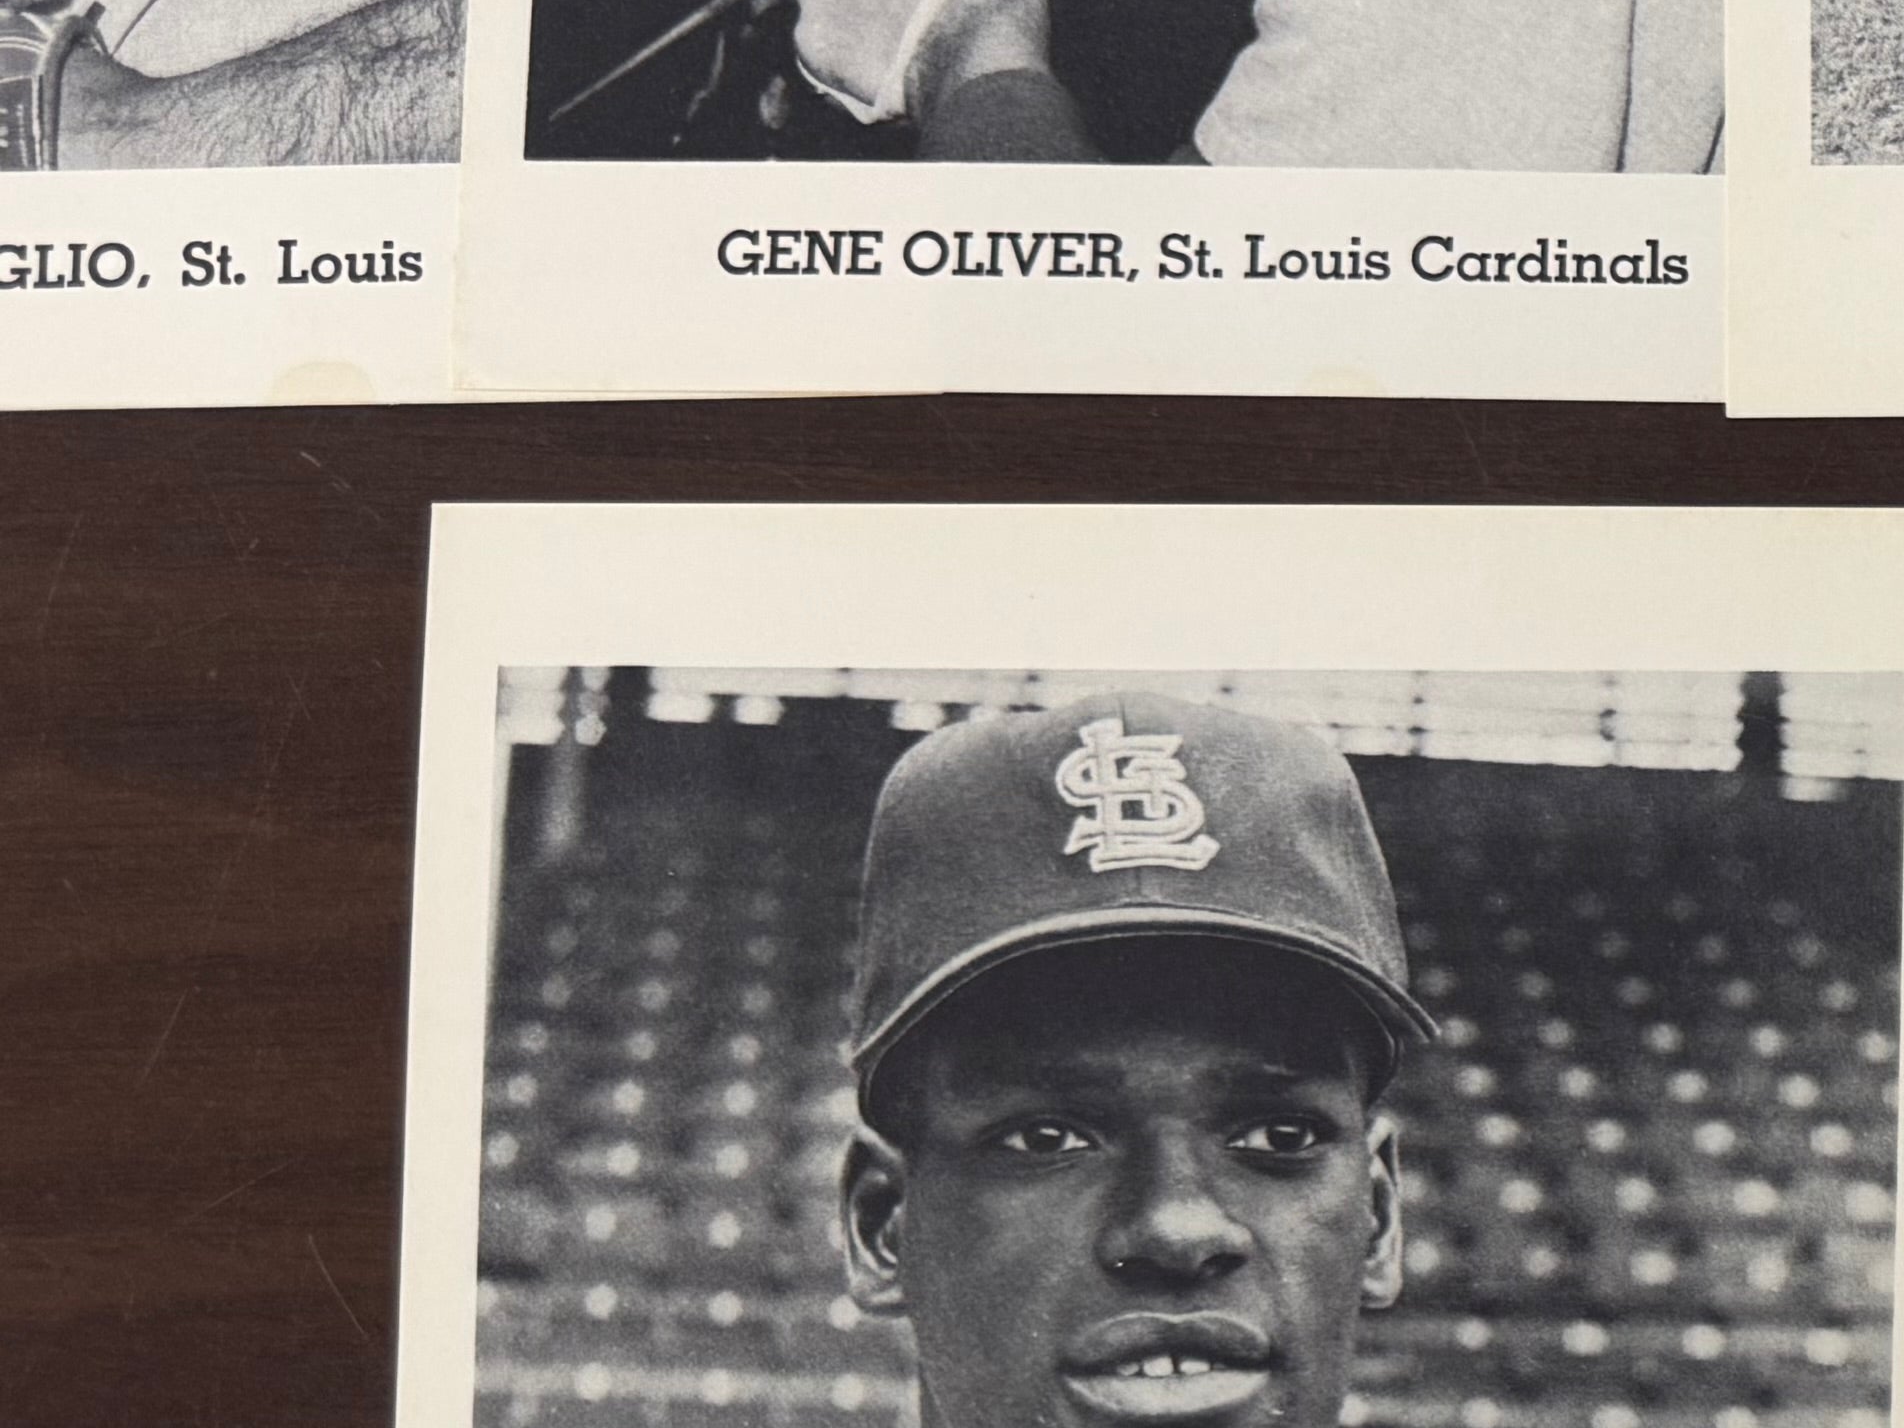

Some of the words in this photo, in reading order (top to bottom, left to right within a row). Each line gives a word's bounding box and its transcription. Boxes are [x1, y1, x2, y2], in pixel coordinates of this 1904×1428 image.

[181, 240, 247, 288] St.
[276, 238, 424, 285] Louis
[716, 228, 884, 277] GENE
[901, 229, 1140, 283] OLIVER,
[1157, 232, 1224, 280] St.
[1242, 233, 1392, 282] Louis
[1410, 234, 1690, 286] Cardinals
